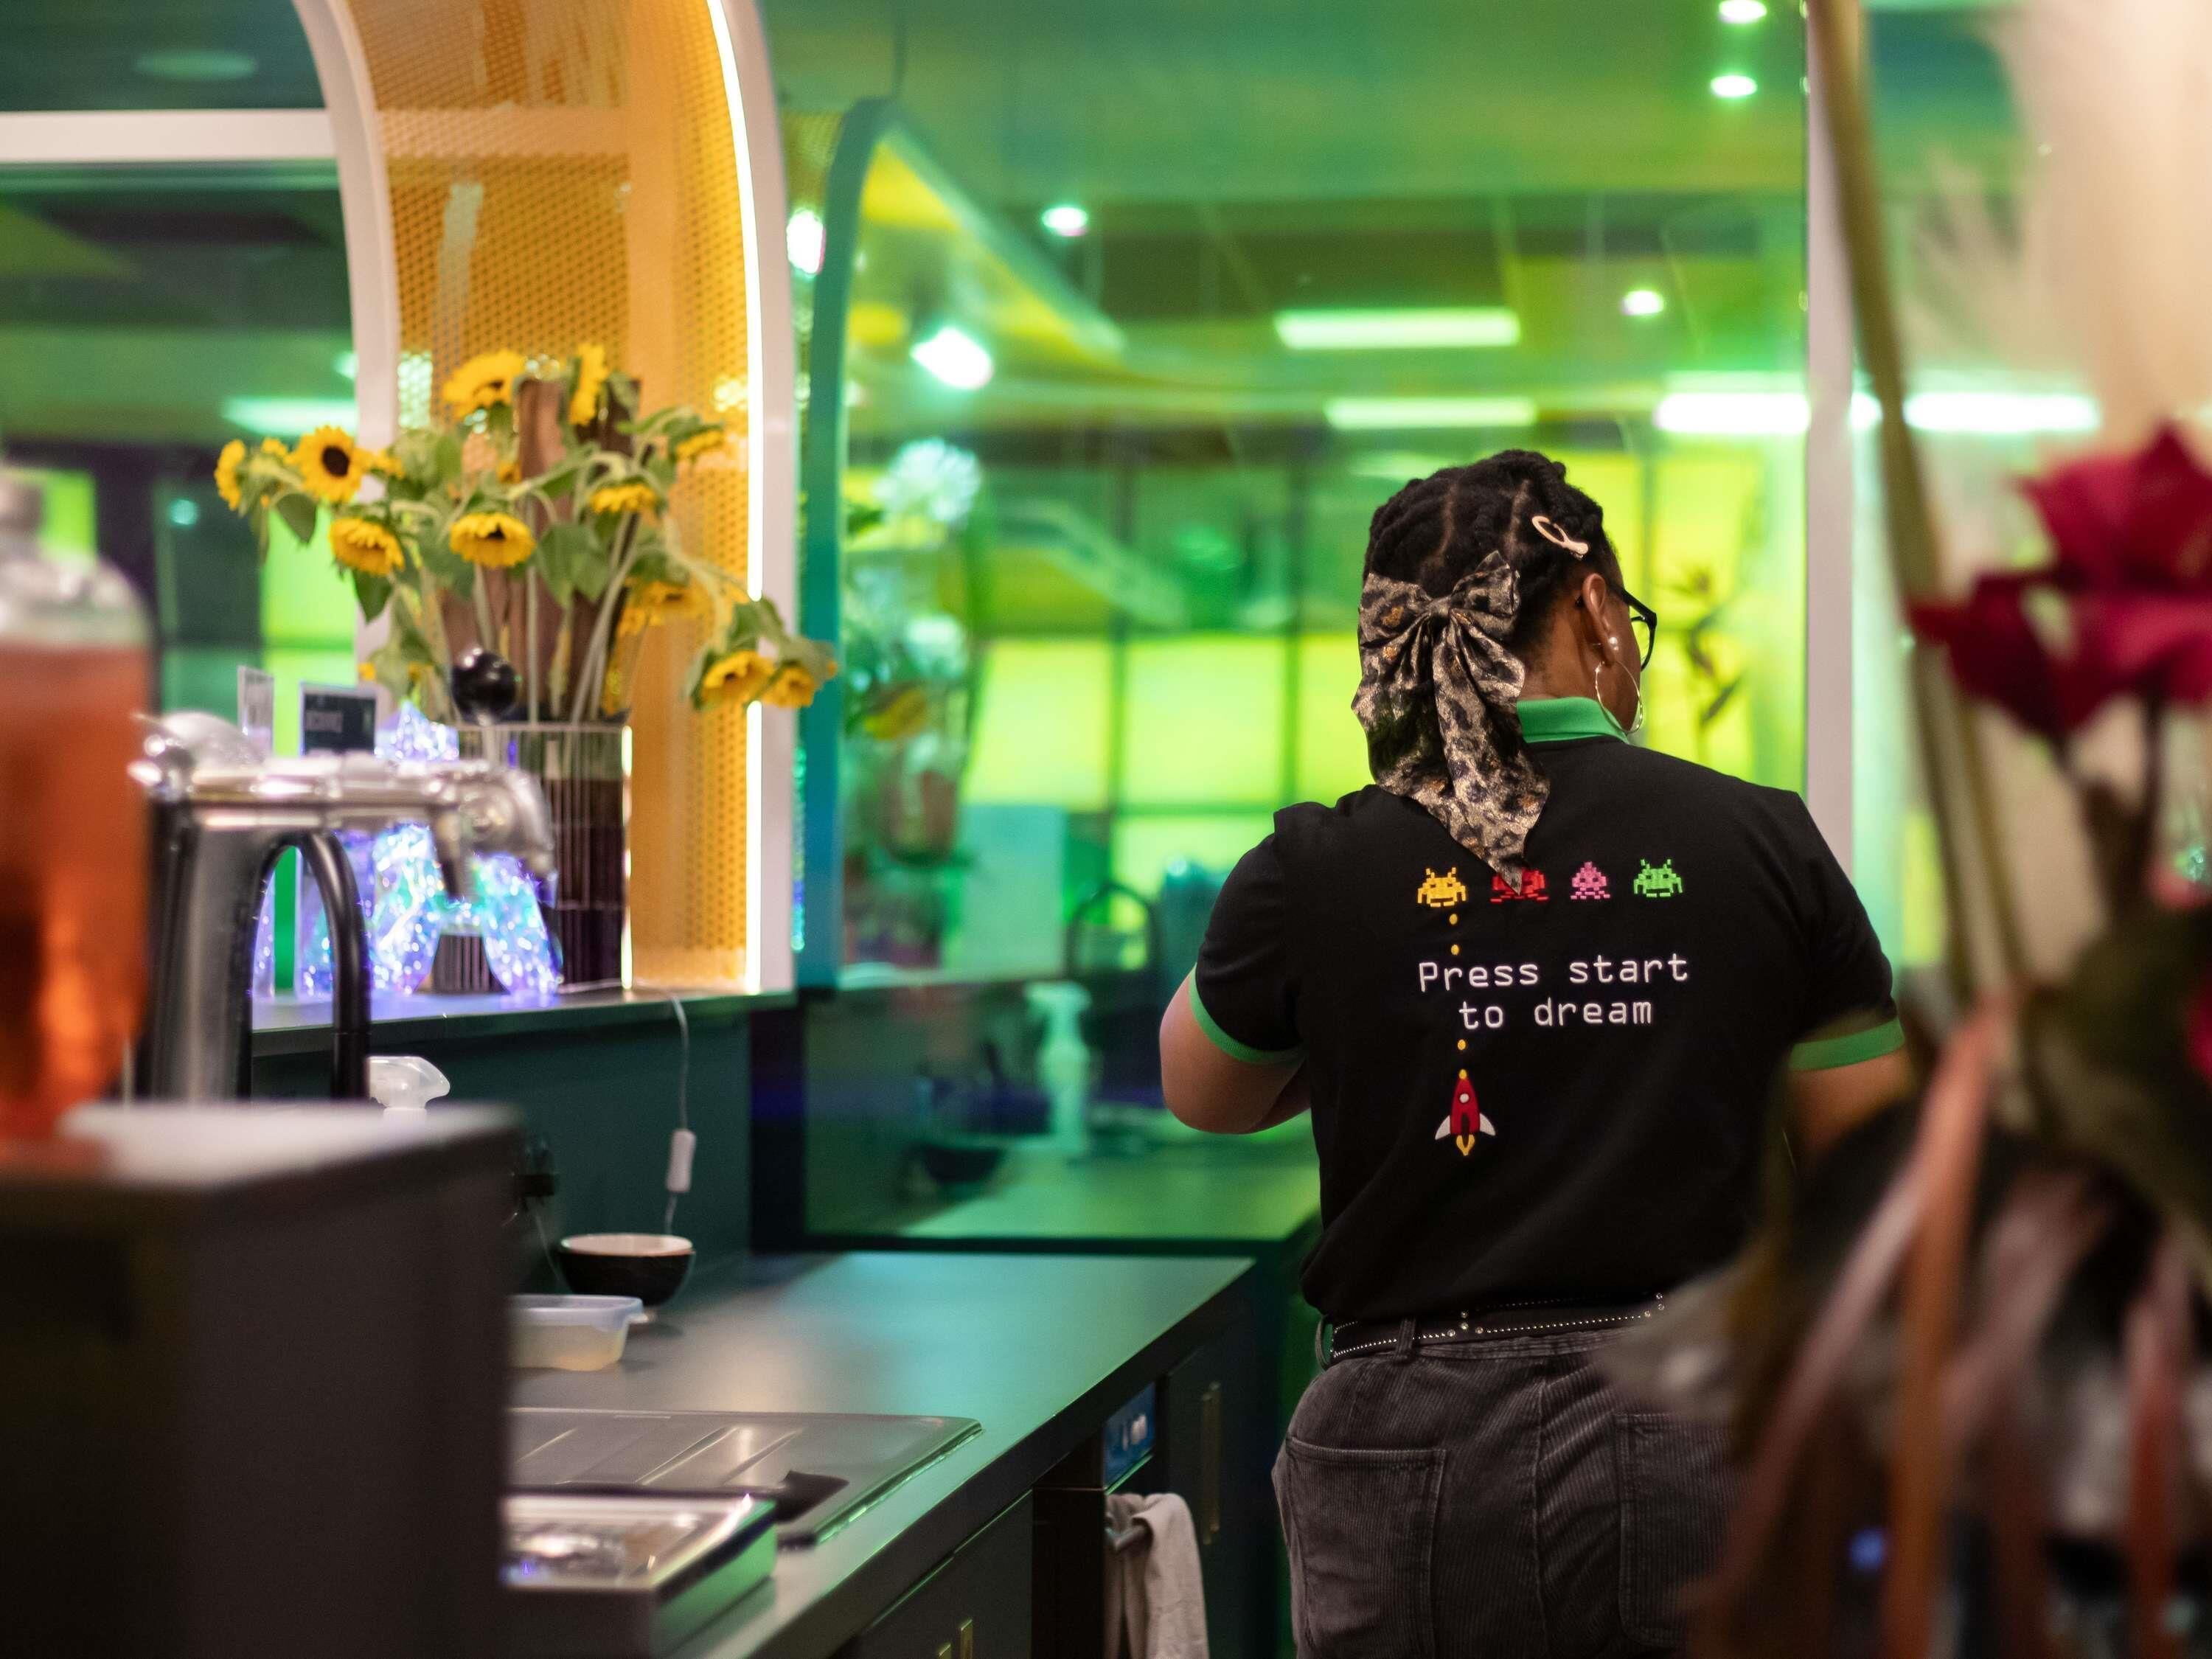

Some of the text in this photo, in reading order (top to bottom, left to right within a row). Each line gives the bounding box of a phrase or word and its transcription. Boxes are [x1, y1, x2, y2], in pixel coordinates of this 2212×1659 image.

[1419, 953, 1688, 992] Press start
[1458, 997, 1652, 1030] to dream
